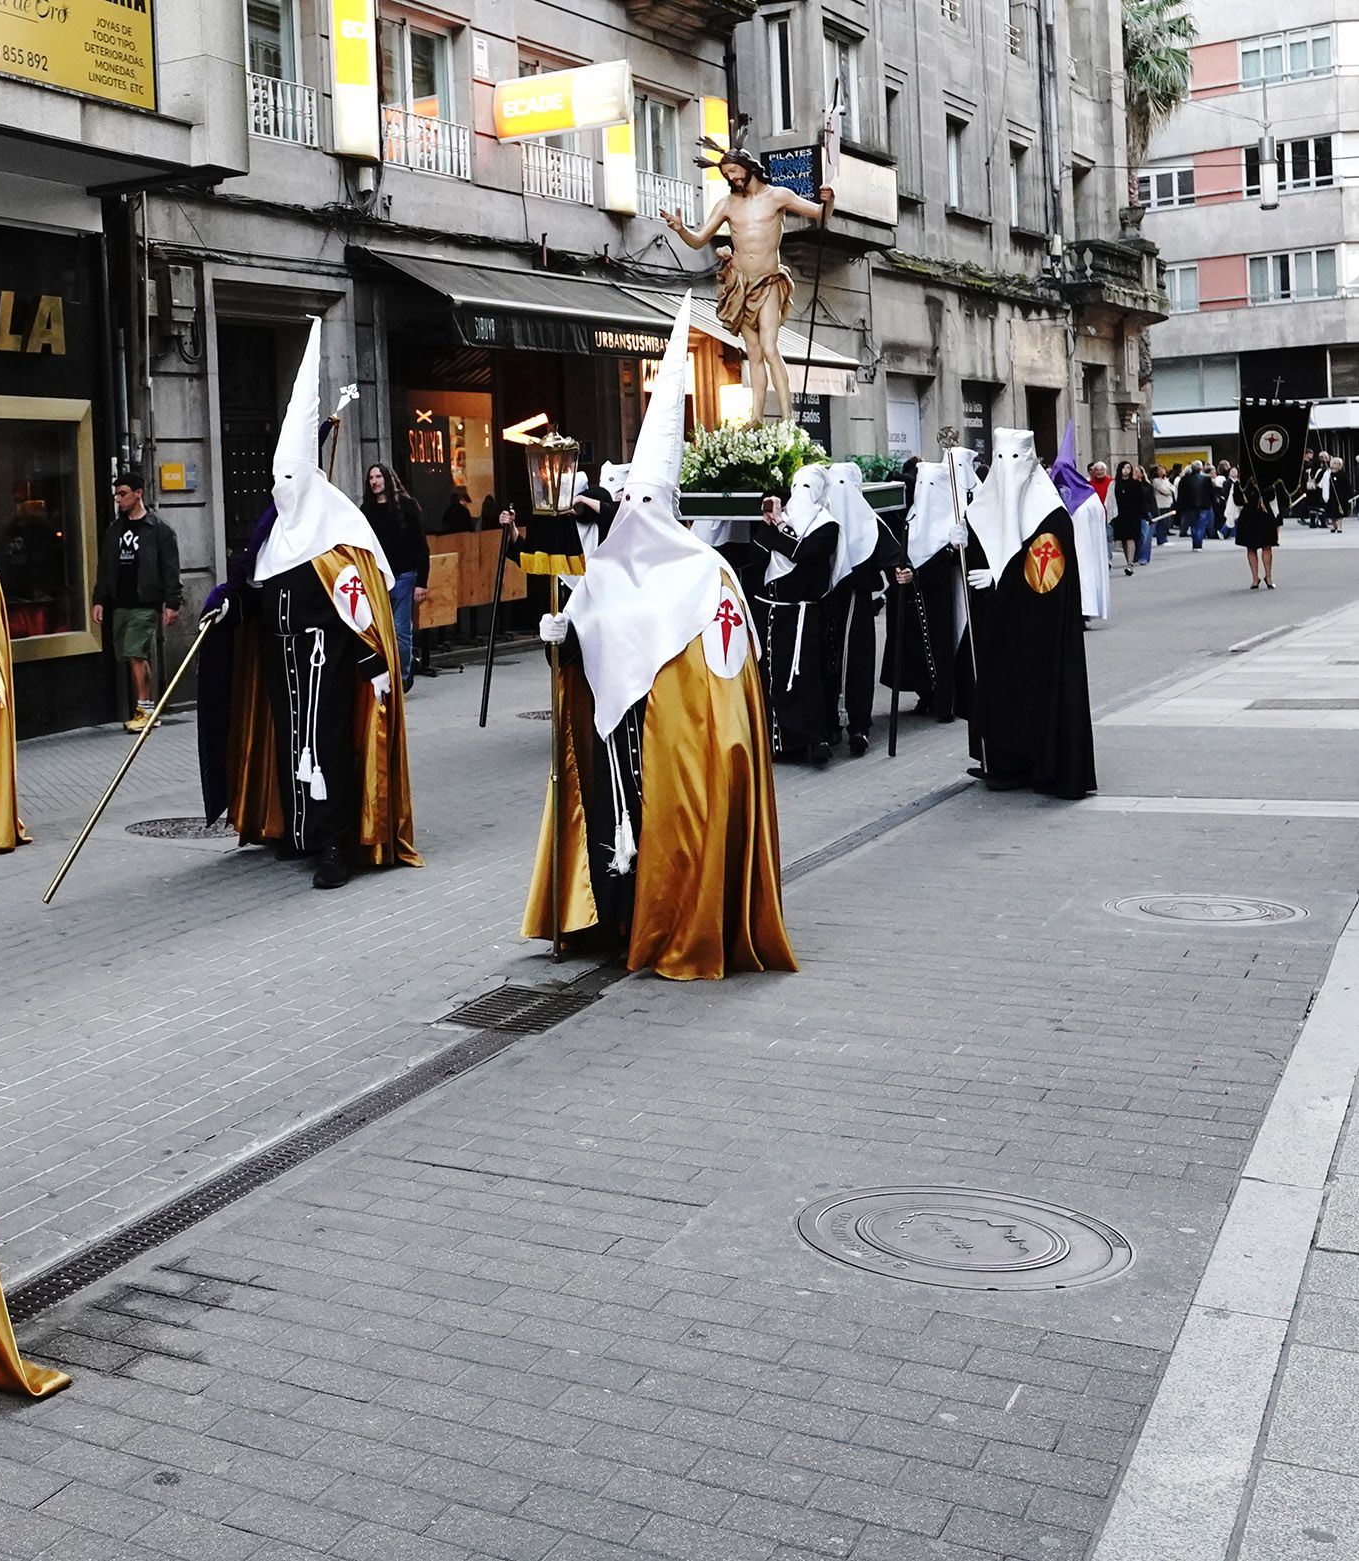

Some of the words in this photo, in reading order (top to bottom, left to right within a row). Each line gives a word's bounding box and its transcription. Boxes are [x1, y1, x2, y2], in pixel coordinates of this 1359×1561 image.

[95, 17, 121, 35] JOYAS
[121, 25, 132, 37] DE
[92, 30, 116, 46] TODO
[3, 45, 24, 65] 855
[27, 51, 49, 72] 892
[84, 42, 146, 69] DETERIORADAS,
[94, 59, 137, 79] MONEDAS,
[130, 84, 144, 96] ETC
[503, 92, 563, 118] ECADE
[768, 148, 813, 161] PILATES
[409, 430, 444, 463] SIBUYA
